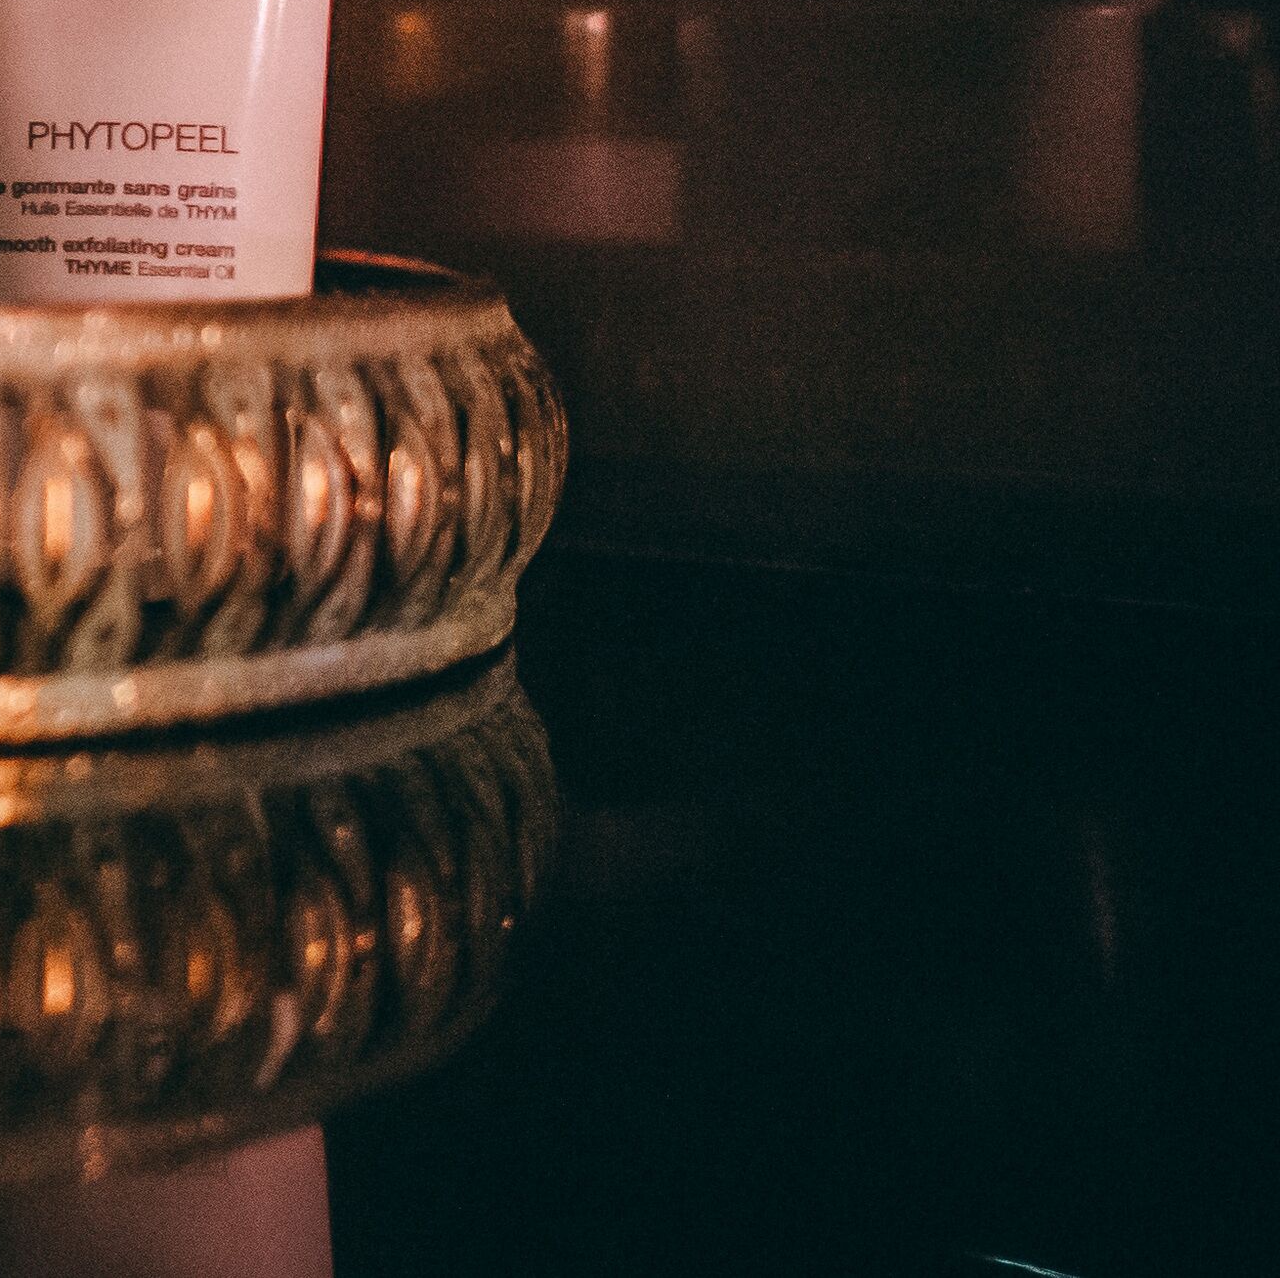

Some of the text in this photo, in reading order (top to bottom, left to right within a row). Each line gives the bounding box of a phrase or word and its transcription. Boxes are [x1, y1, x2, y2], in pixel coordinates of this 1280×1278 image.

[28, 122, 239, 154] PHYTOPEEL
[11, 180, 116, 199] gommante
[122, 181, 171, 197] sans
[177, 181, 237, 200] grains
[20, 200, 237, 220] Huile Essentielle de THYM
[62, 238, 169, 258] exfoliating
[175, 242, 235, 258] cream
[65, 259, 131, 276] THYME
